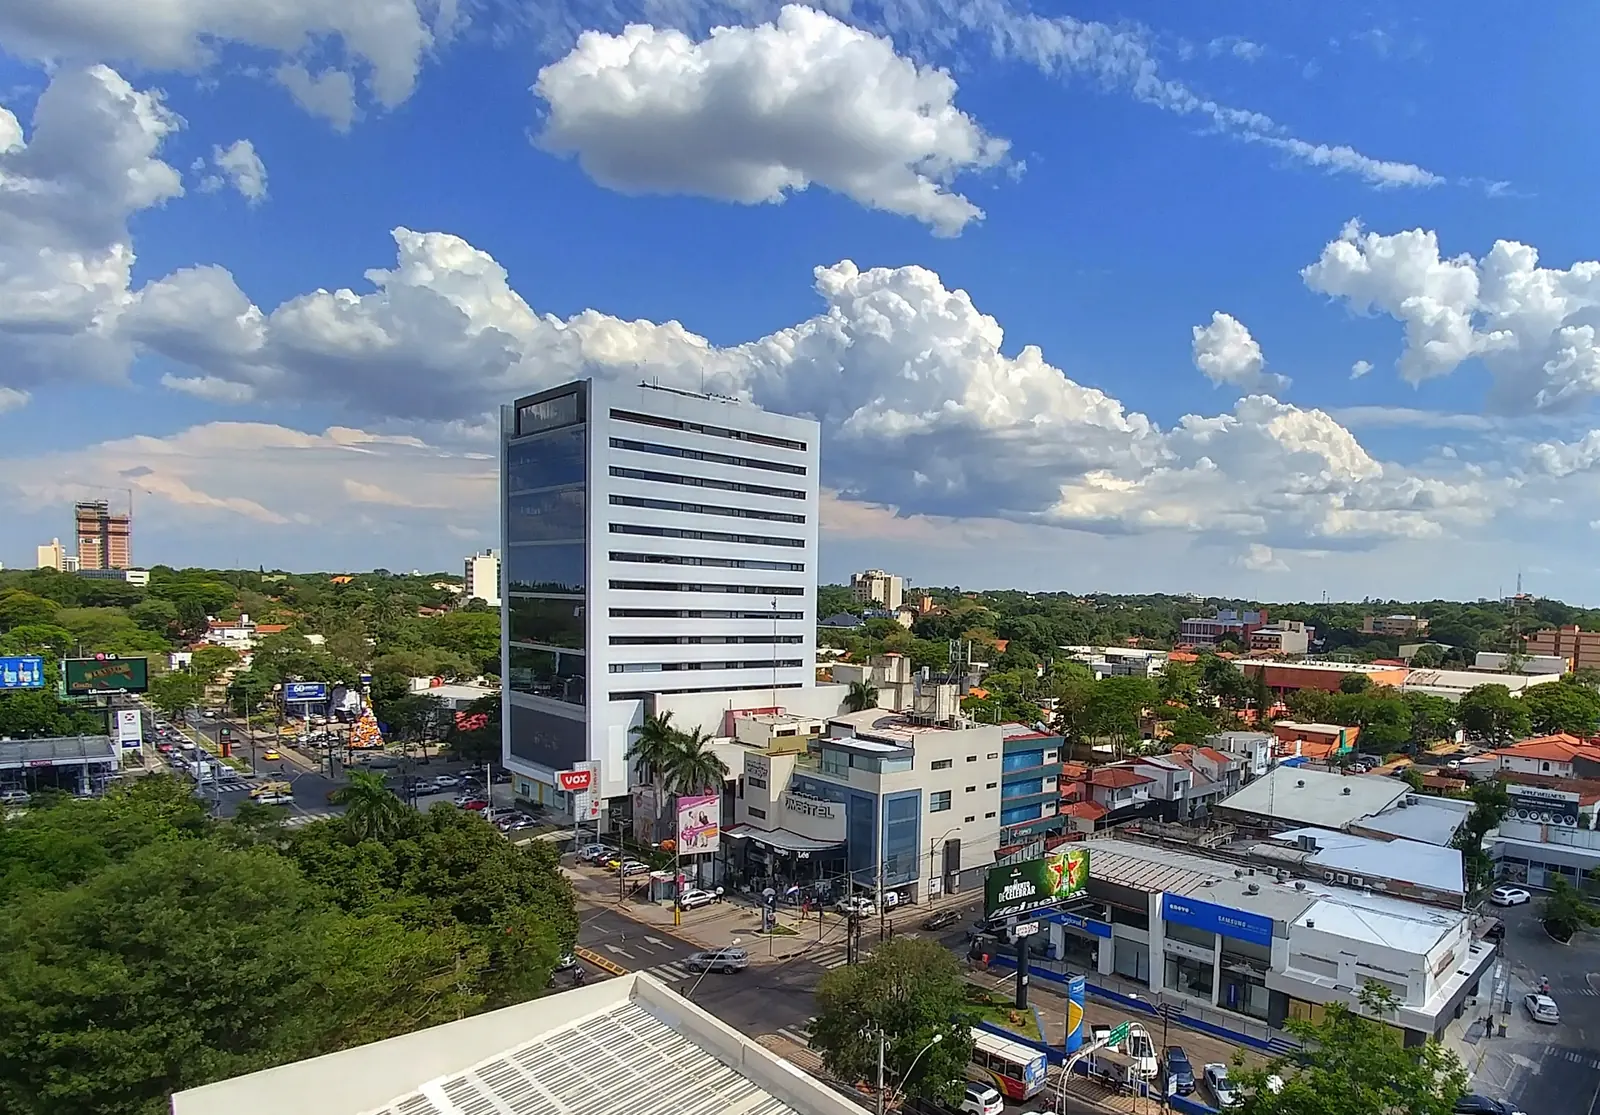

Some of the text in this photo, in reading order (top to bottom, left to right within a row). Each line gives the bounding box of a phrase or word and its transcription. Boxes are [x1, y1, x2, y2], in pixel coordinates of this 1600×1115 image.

[293, 684, 305, 692] 60
[565, 774, 587, 785] VOX
[1005, 885, 1036, 901] CELEBRAR
[988, 888, 1089, 919] Heineken
[1061, 914, 1082, 927] Regional
[1218, 915, 1247, 928] SAMSUNG
